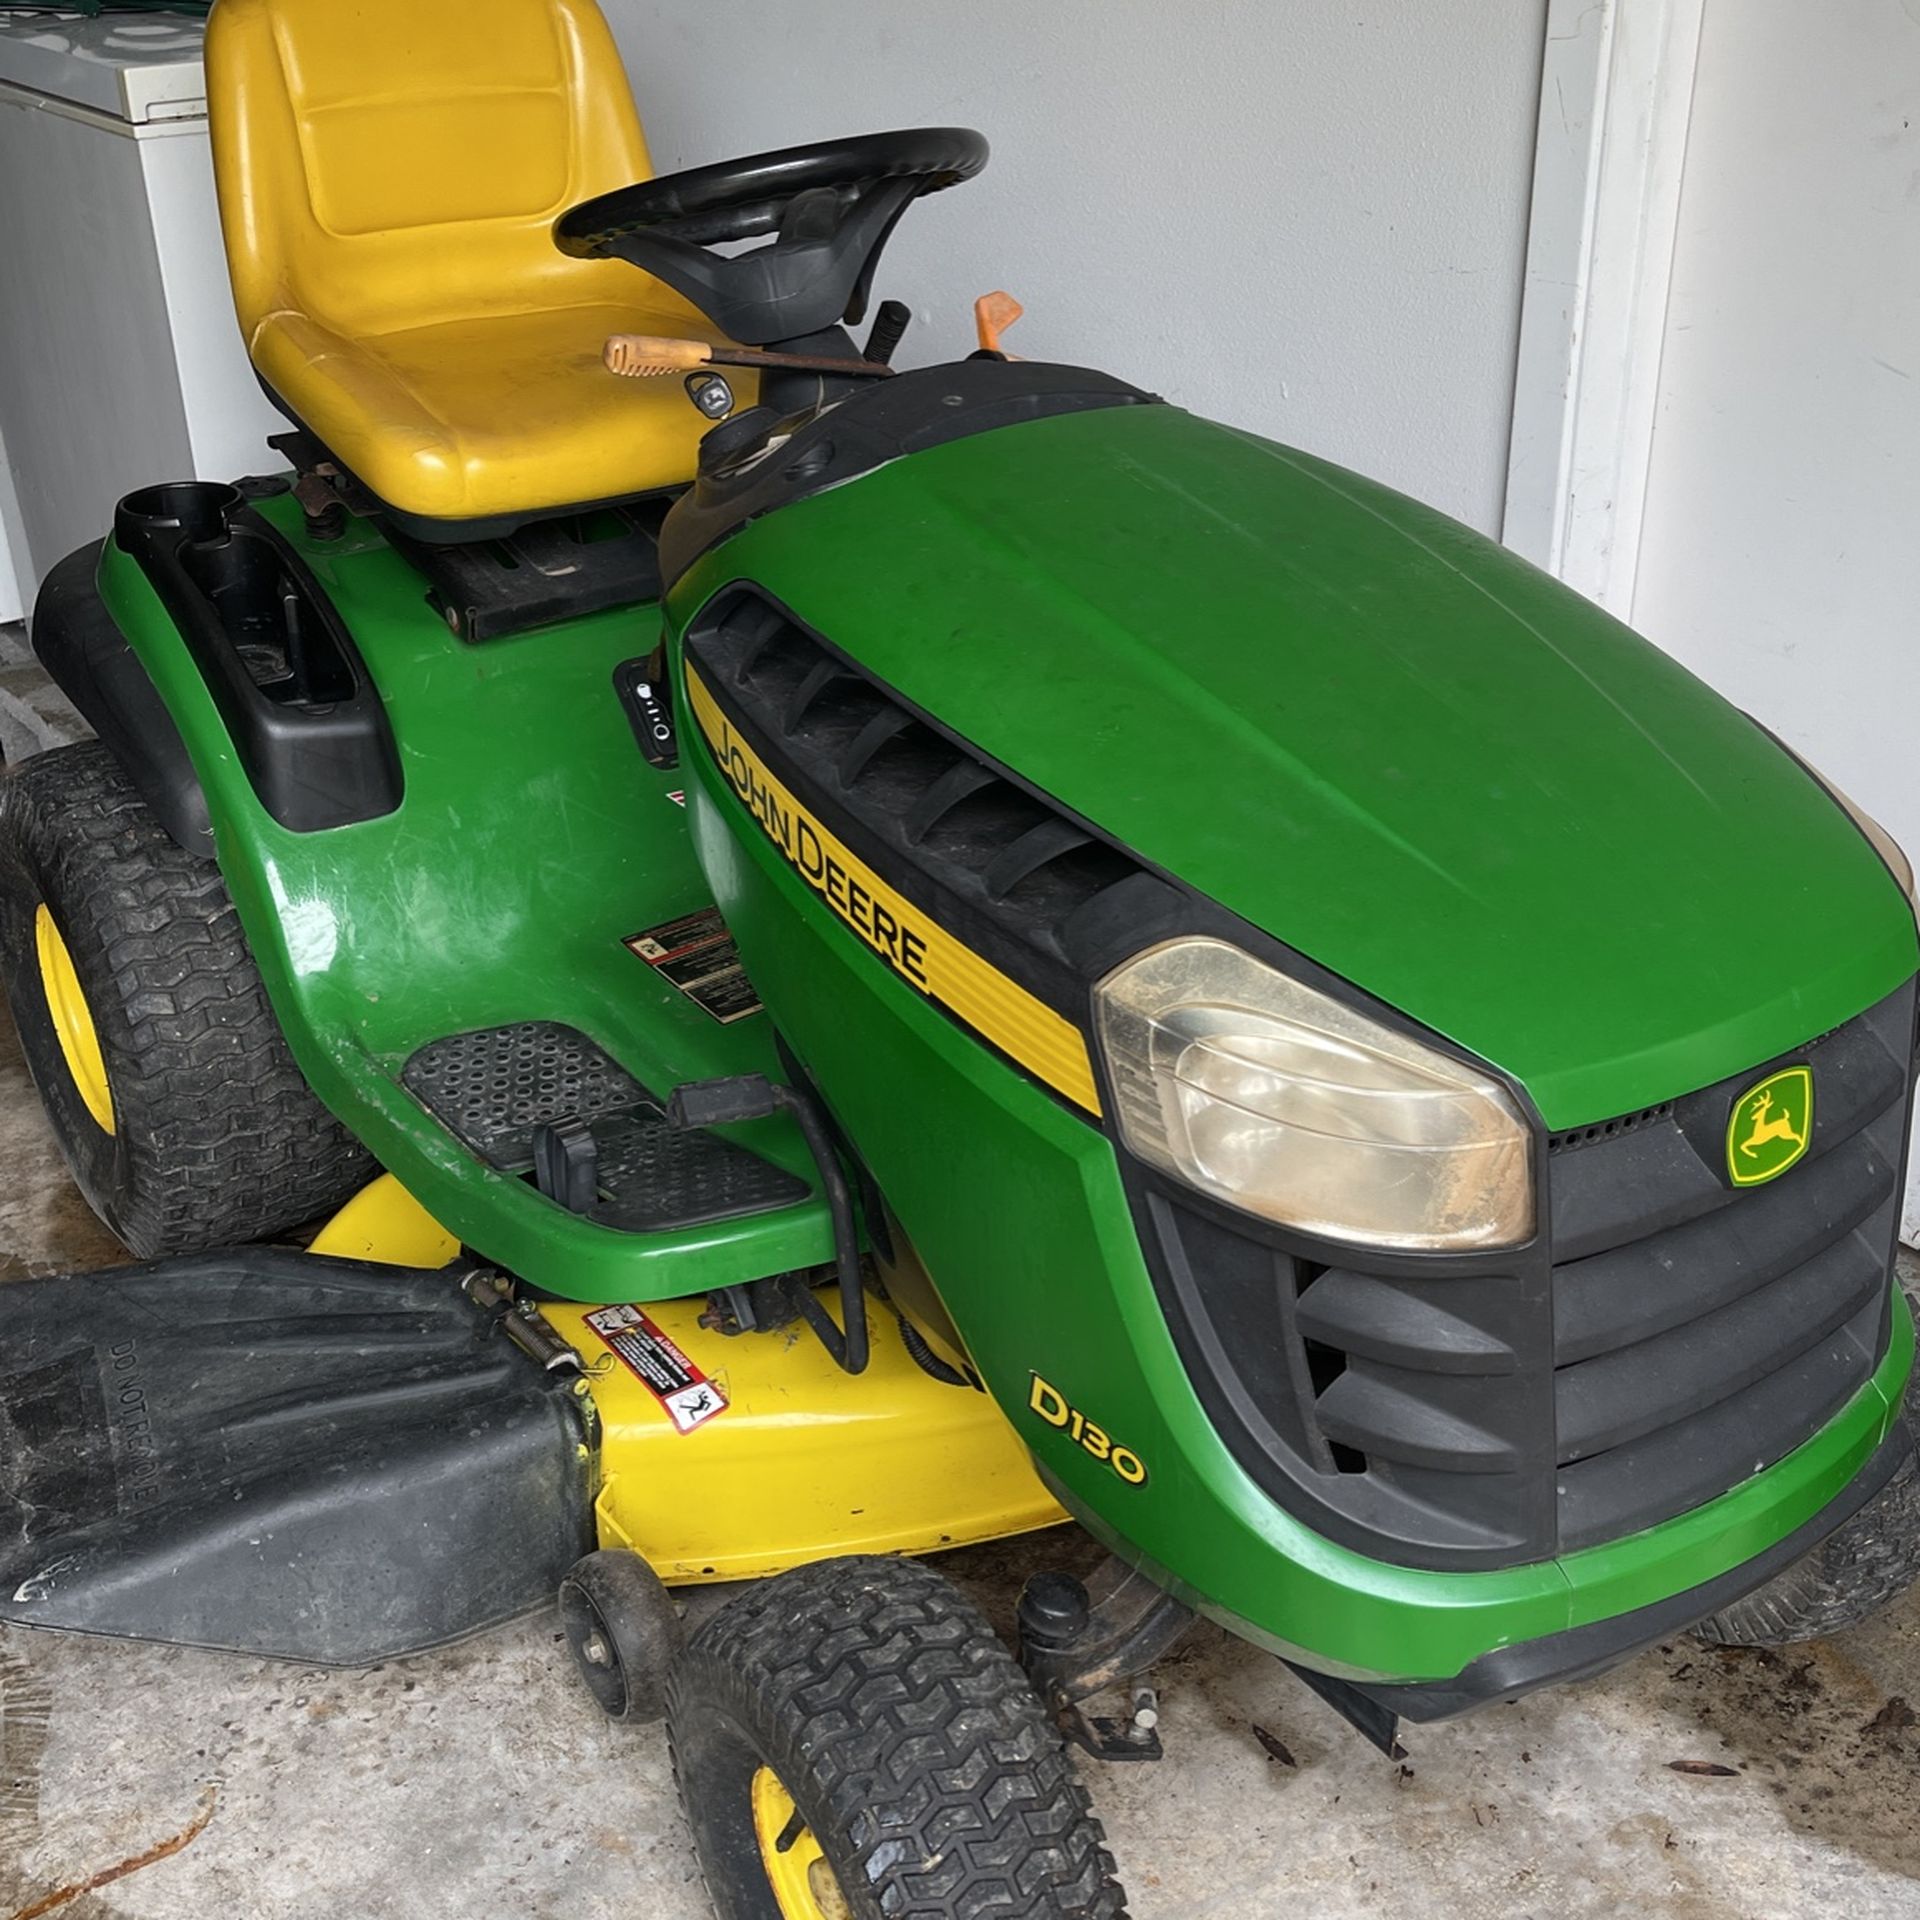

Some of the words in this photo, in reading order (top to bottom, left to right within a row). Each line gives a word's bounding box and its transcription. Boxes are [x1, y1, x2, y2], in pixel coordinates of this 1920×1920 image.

[717, 721, 790, 852] JOHN
[797, 815, 928, 985] DEERE
[111, 1339, 137, 1371] DO
[660, 1340, 693, 1370] DANGER
[117, 1374, 147, 1416] NOT
[1029, 1374, 1146, 1484] D130
